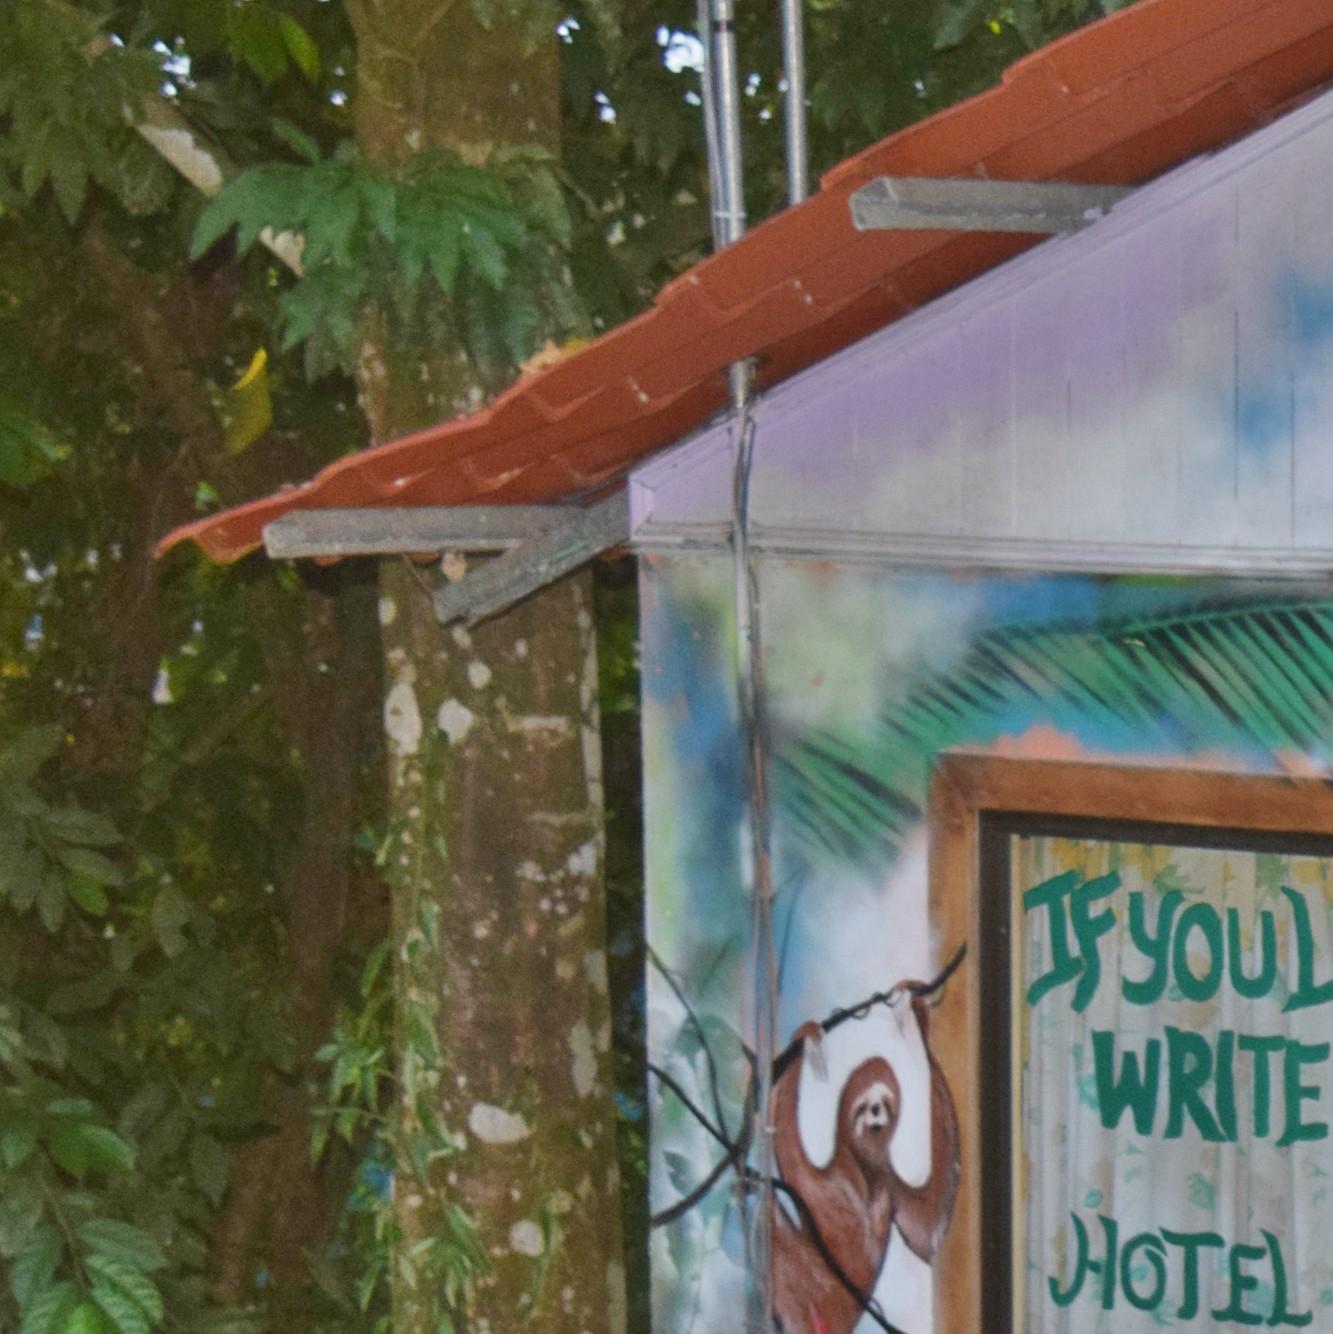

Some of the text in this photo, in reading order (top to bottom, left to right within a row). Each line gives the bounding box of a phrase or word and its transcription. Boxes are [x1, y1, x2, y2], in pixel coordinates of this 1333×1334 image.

[1022, 868, 1122, 1014] IF
[1121, 890, 1278, 1006] YOU
[1091, 1025, 1331, 1148] WRITE
[1048, 1211, 1313, 1328] HOTEL
